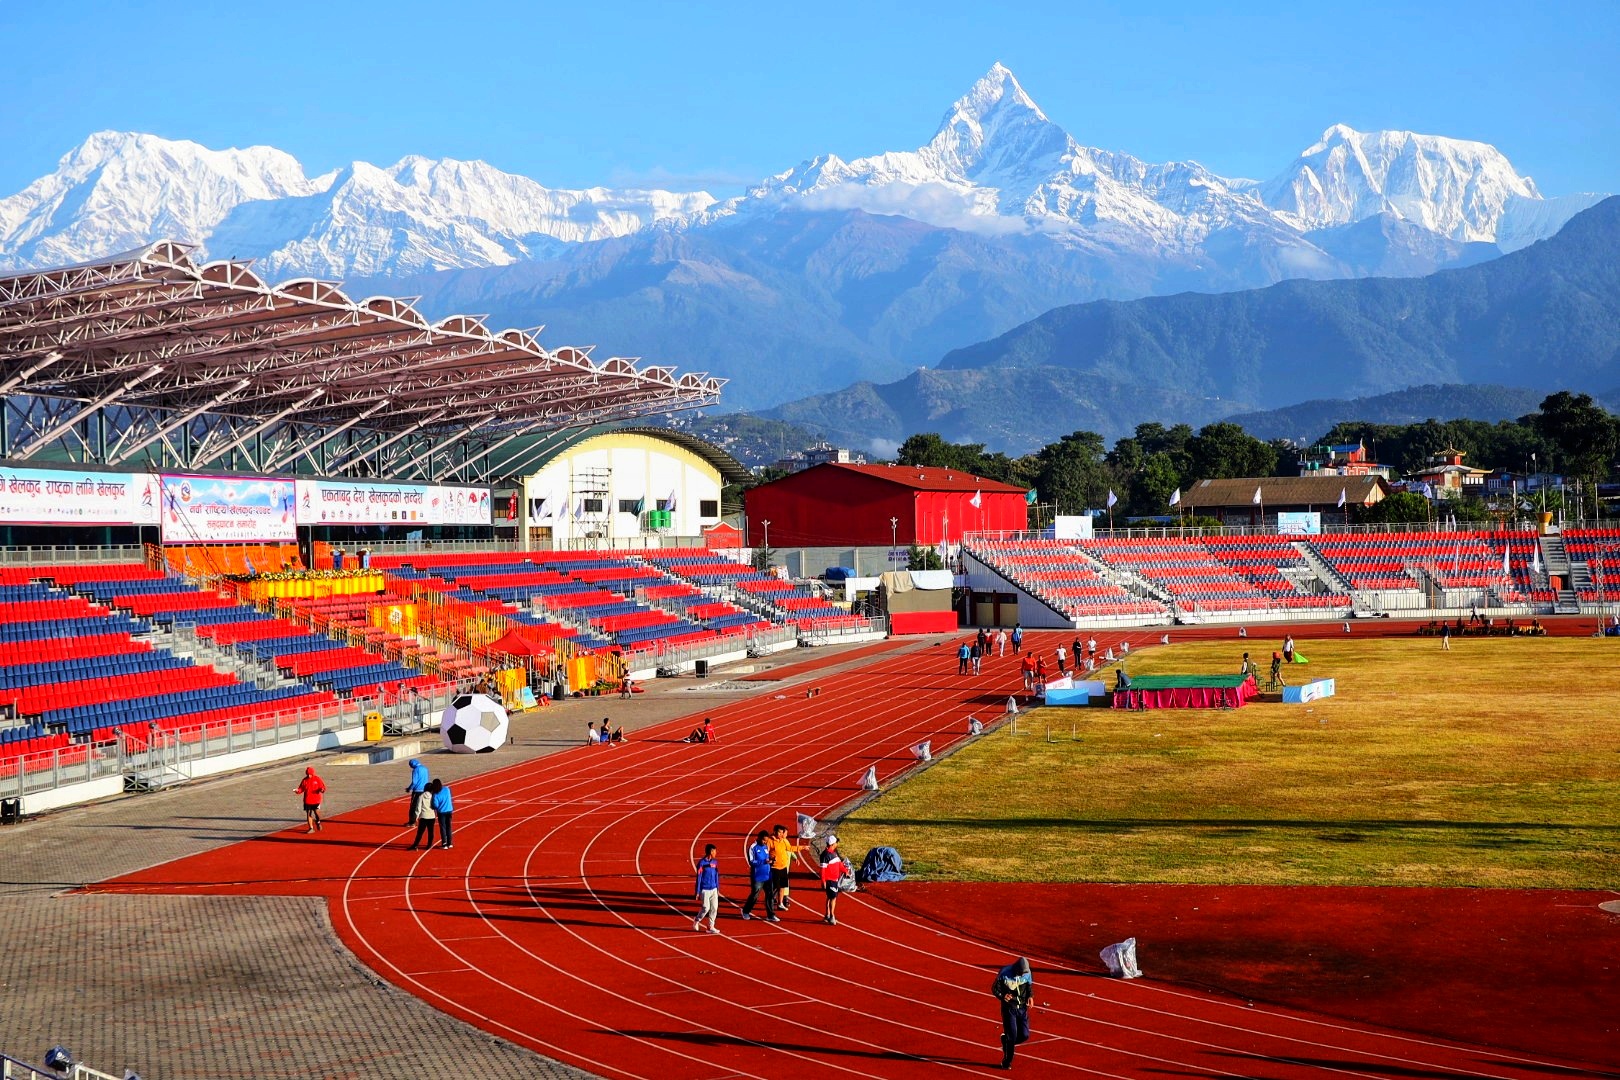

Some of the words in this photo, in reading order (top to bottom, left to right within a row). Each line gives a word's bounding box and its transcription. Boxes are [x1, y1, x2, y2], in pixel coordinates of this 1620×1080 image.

[76, 478, 94, 496] लागि
[353, 487, 365, 504] देश
[368, 487, 402, 507] खेलकुदको
